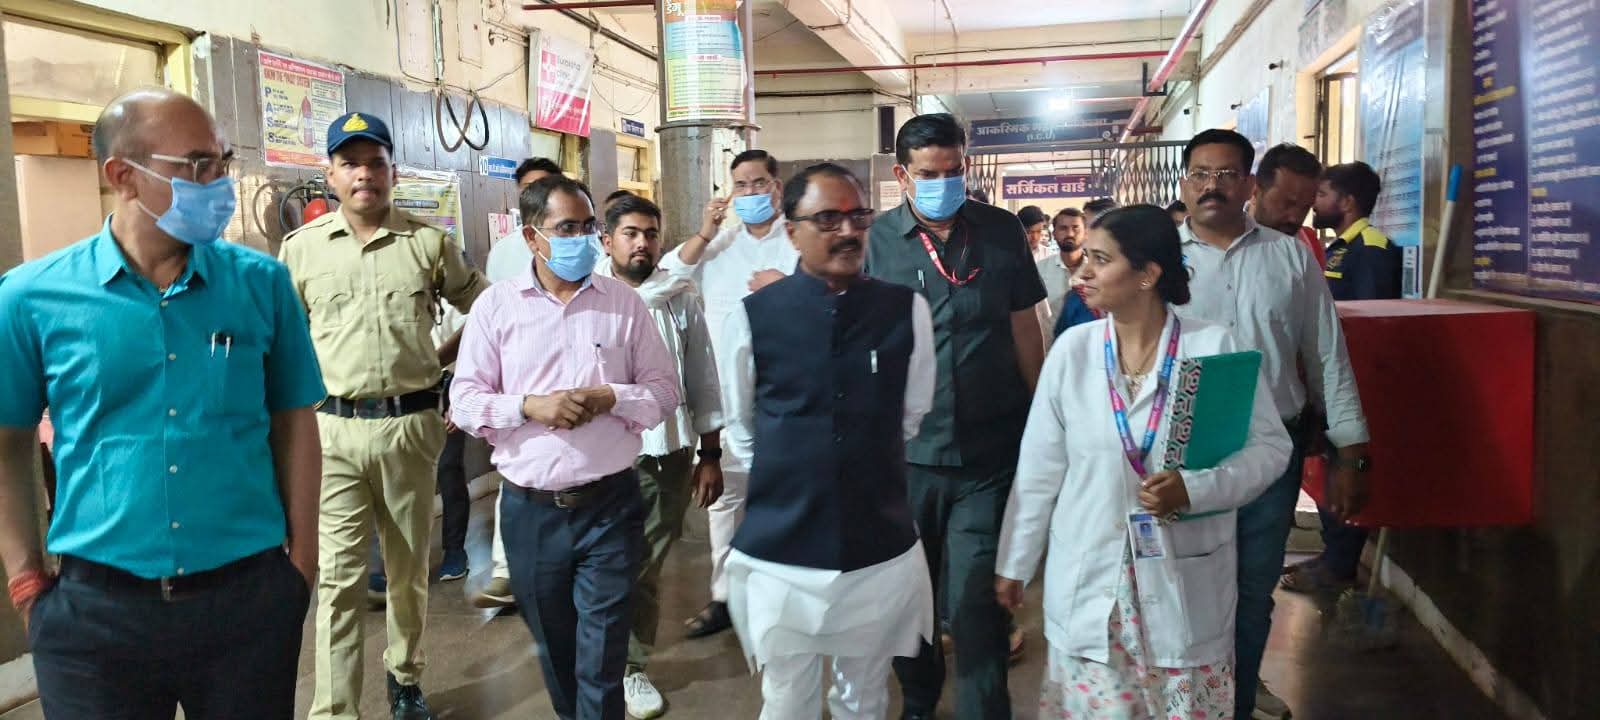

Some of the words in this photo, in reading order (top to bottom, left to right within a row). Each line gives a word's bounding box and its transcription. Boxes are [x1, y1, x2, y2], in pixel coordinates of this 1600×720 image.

[265, 87, 271, 97] P
[266, 102, 274, 113] A
[267, 117, 274, 127] S
[268, 132, 275, 142] S
[480, 158, 488, 174] 10
[1006, 179, 1059, 195] सर्जिकल
[1061, 178, 1086, 193] वार्ड
[498, 214, 508, 233] 10
